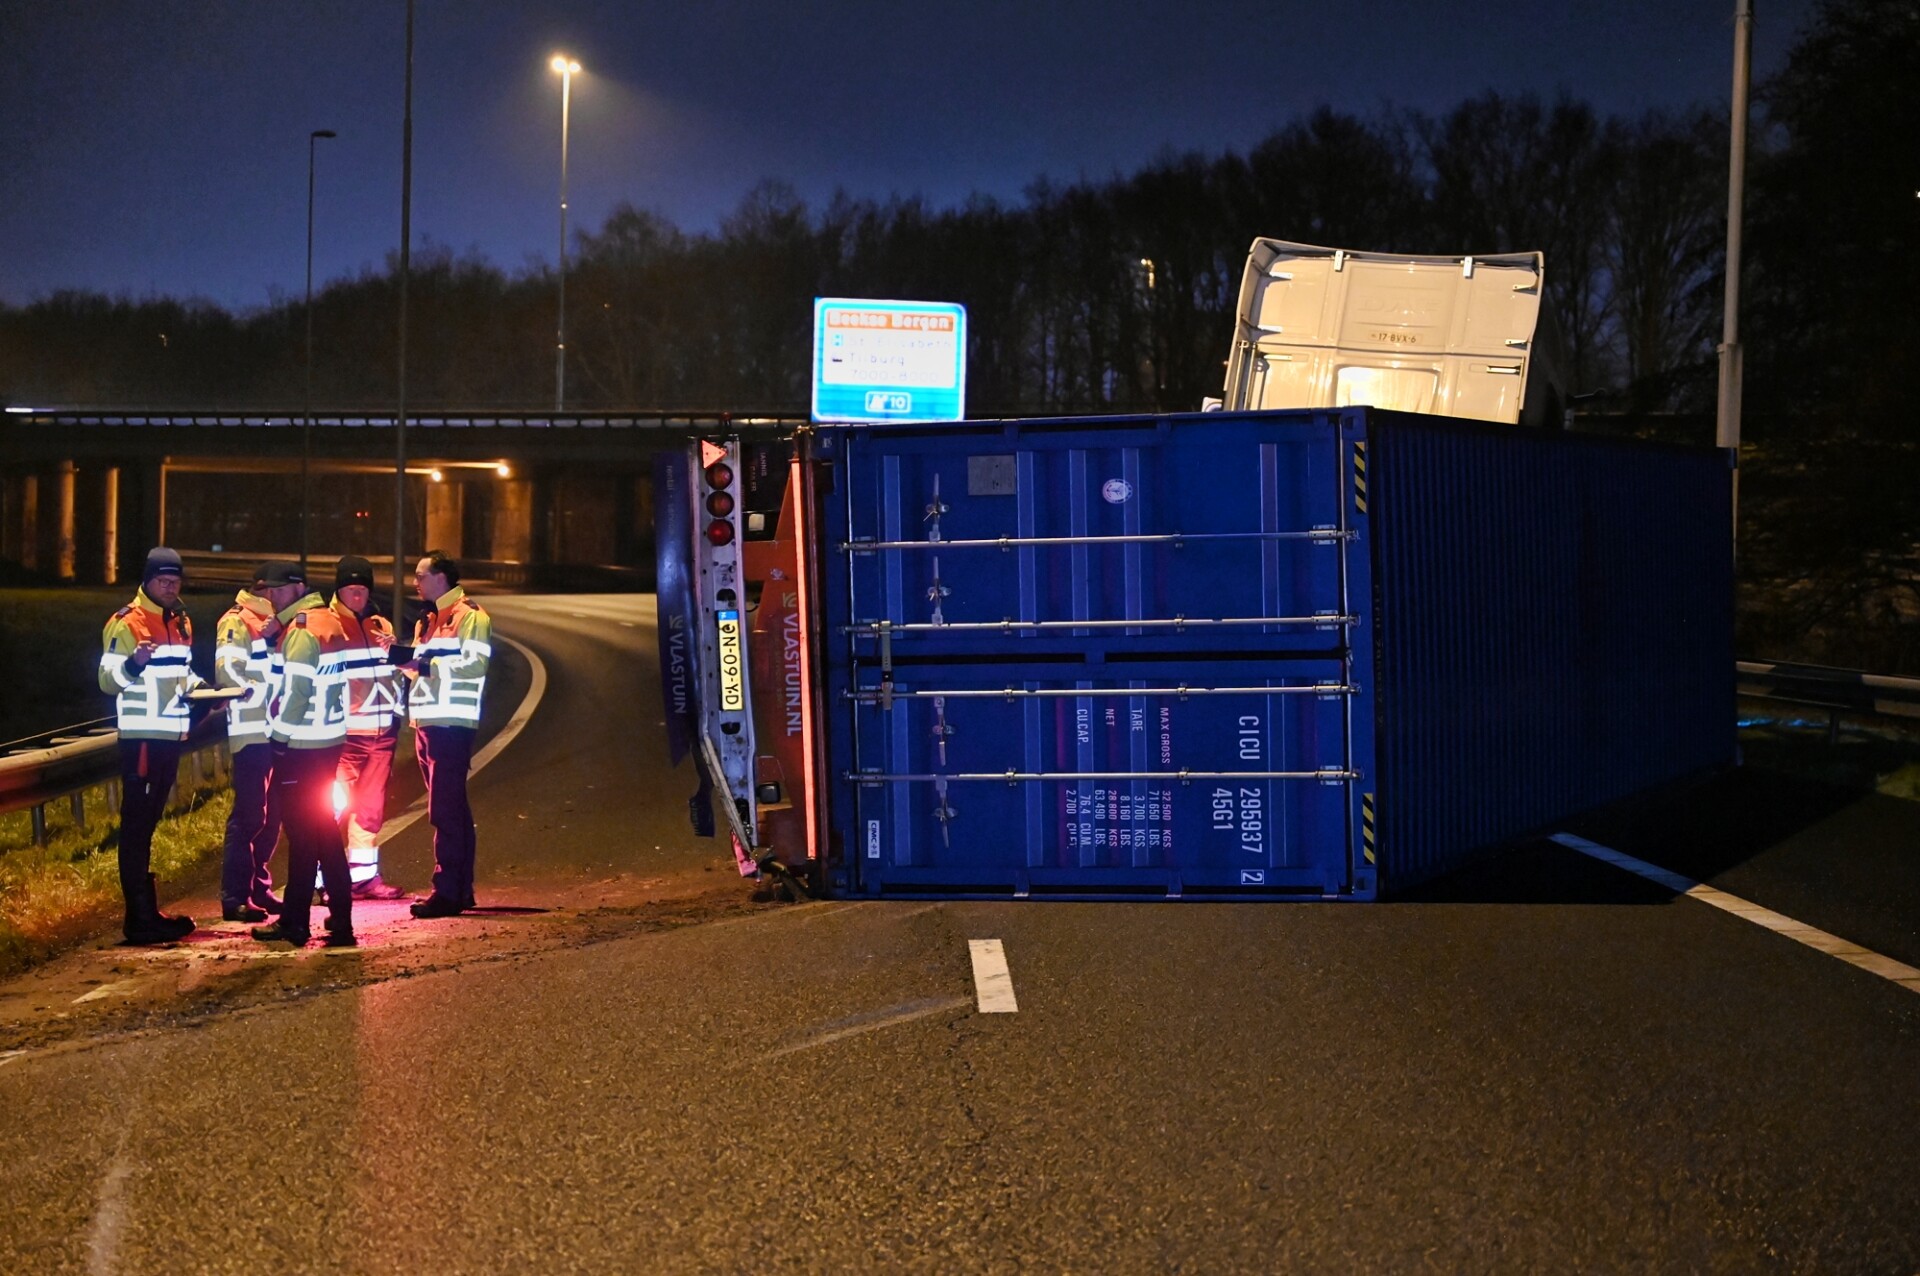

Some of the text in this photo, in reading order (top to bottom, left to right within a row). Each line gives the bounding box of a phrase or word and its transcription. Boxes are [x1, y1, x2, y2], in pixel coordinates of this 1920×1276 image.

[848, 351, 906, 366] Tilburg
[890, 396, 906, 409] 10
[669, 633, 687, 714] VLASTUIN
[783, 613, 803, 736] VLASTUIN.NL
[1077, 708, 1089, 746] CU.CAP.
[1105, 708, 1115, 727] NET
[1131, 708, 1143, 732] TARE
[1160, 707, 1170, 731] MAX
[1161, 733, 1171, 764] GROSS
[1066, 789, 1077, 815] 2.700
[1080, 794, 1091, 815] 76.4
[1095, 789, 1106, 820] 63.490
[1108, 790, 1118, 821] 28.800
[1120, 795, 1131, 821] 8.160
[1134, 795, 1145, 821] 3.700
[1149, 790, 1160, 821] 71.650
[1162, 790, 1172, 821] 32.500
[1212, 788, 1234, 830] 45G1
[1238, 715, 1263, 883] CICU 295937 2
